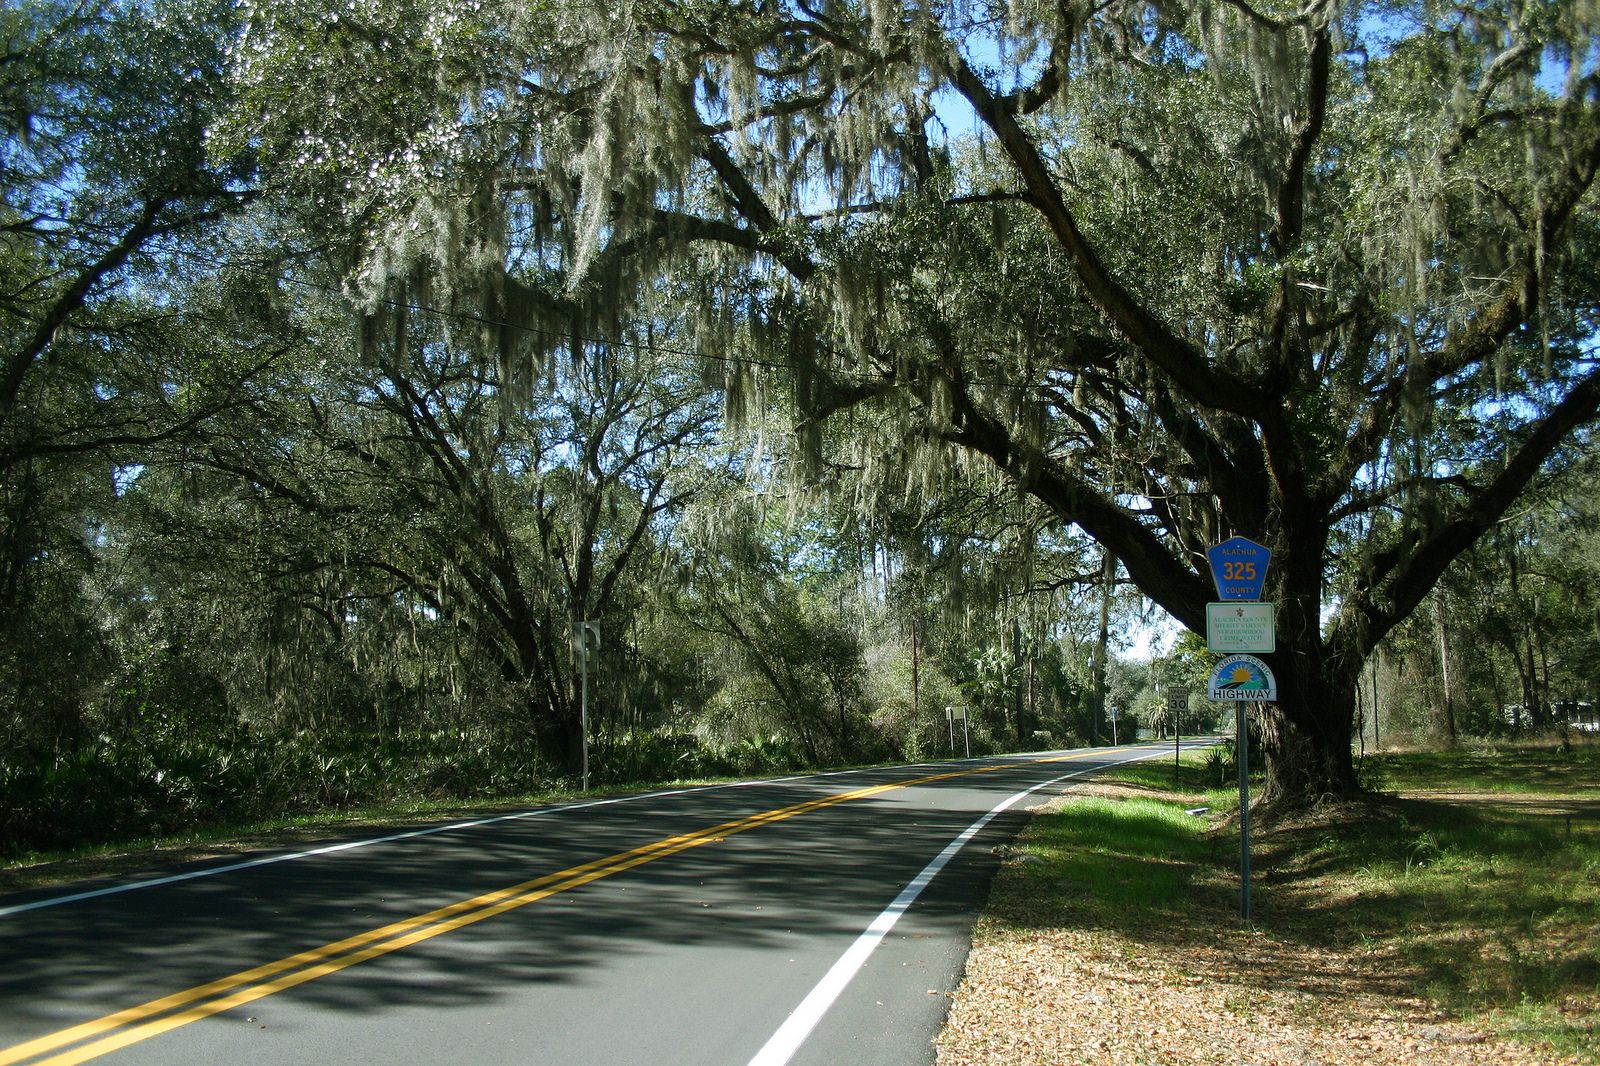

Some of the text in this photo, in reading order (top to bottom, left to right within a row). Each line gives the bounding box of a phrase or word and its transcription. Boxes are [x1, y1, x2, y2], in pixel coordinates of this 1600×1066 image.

[1223, 562, 1257, 580] 325
[1225, 586, 1255, 594] COUNTY
[1213, 655, 1271, 677] FLORIDA SCENIC
[1213, 689, 1271, 699] HIGHWAY
[1170, 699, 1186, 709] 30
